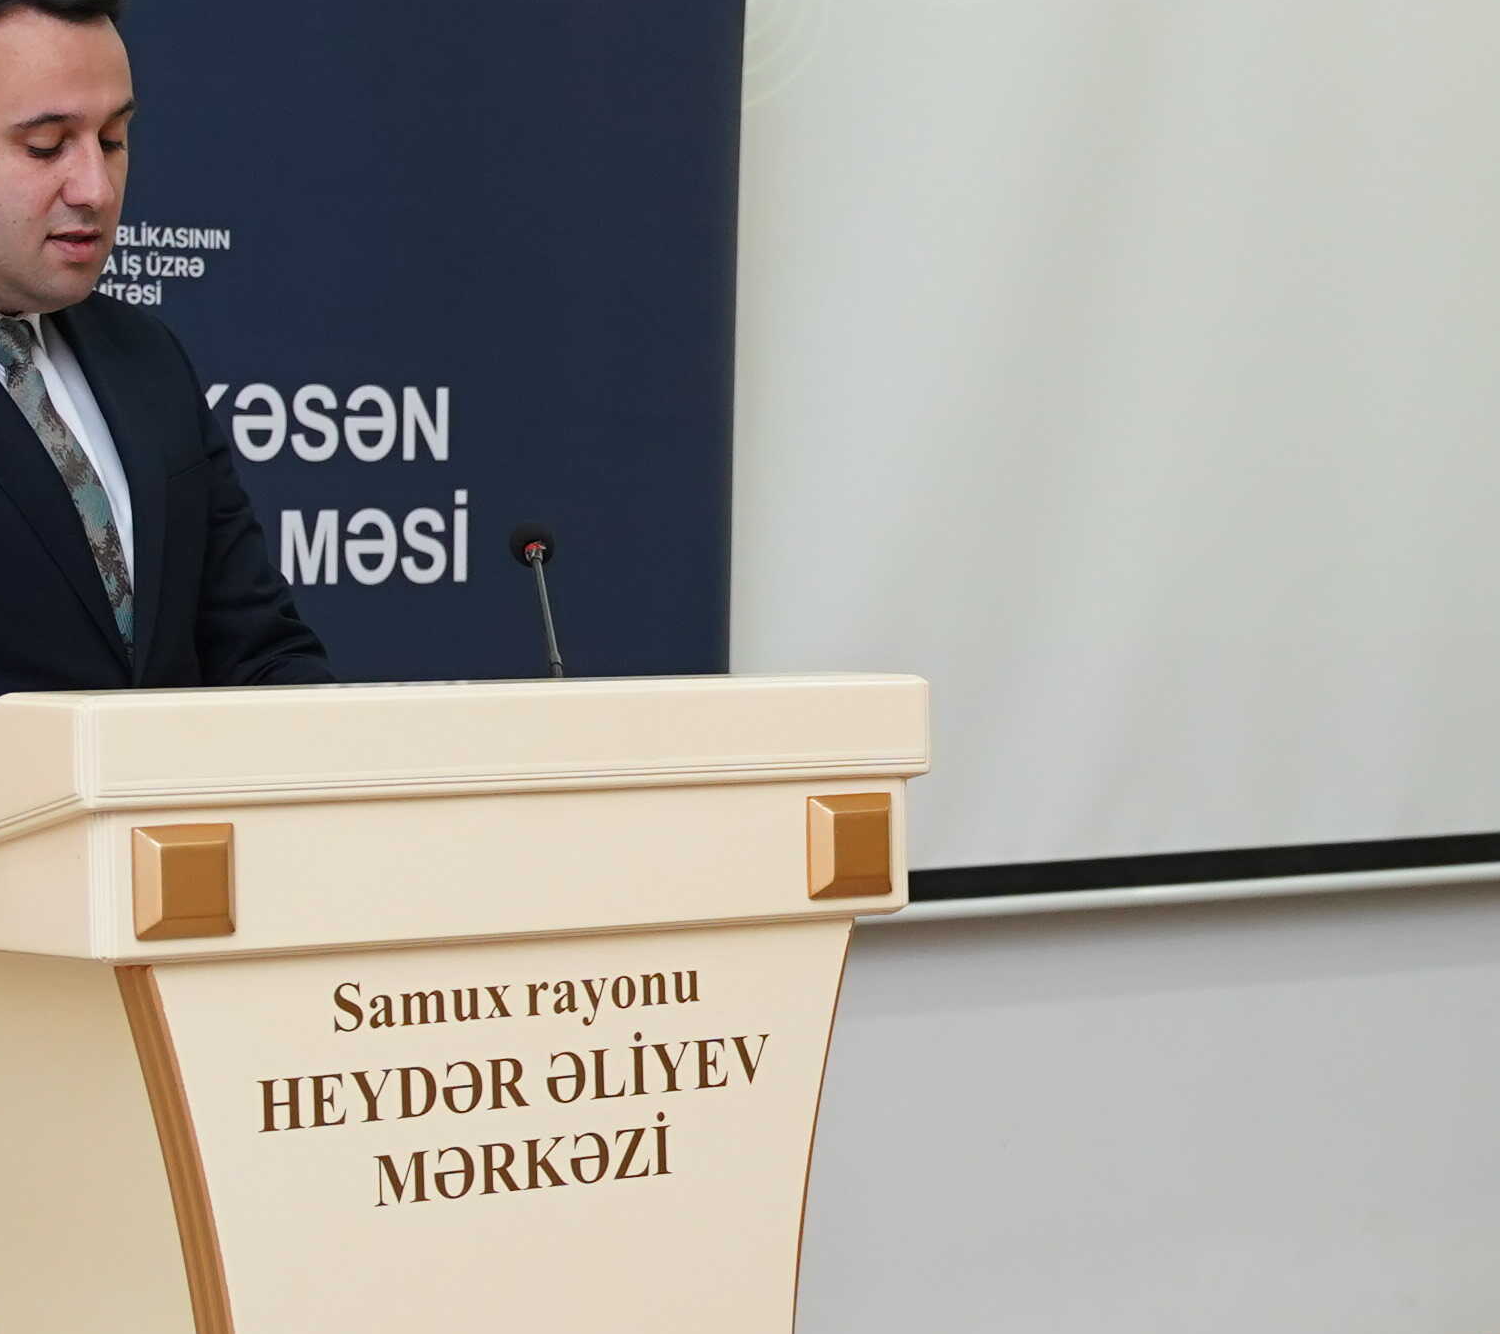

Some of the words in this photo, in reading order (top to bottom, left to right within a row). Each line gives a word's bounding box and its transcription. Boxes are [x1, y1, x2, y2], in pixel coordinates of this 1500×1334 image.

[115, 221, 231, 250] BLİKASININ
[121, 250, 142, 282] İŞ
[146, 250, 205, 278] ÜZRƏ
[93, 278, 162, 306] İTƏSİ
[205, 382, 450, 462] ƏSƏN
[280, 489, 468, 586] MƏSİ
[332, 981, 511, 1034] Samux
[525, 969, 700, 1026] rayonu
[256, 1057, 531, 1134] HEYDƏR
[546, 1031, 770, 1105] ƏLİYEV
[373, 1111, 673, 1208] MƏRKƏZİ
